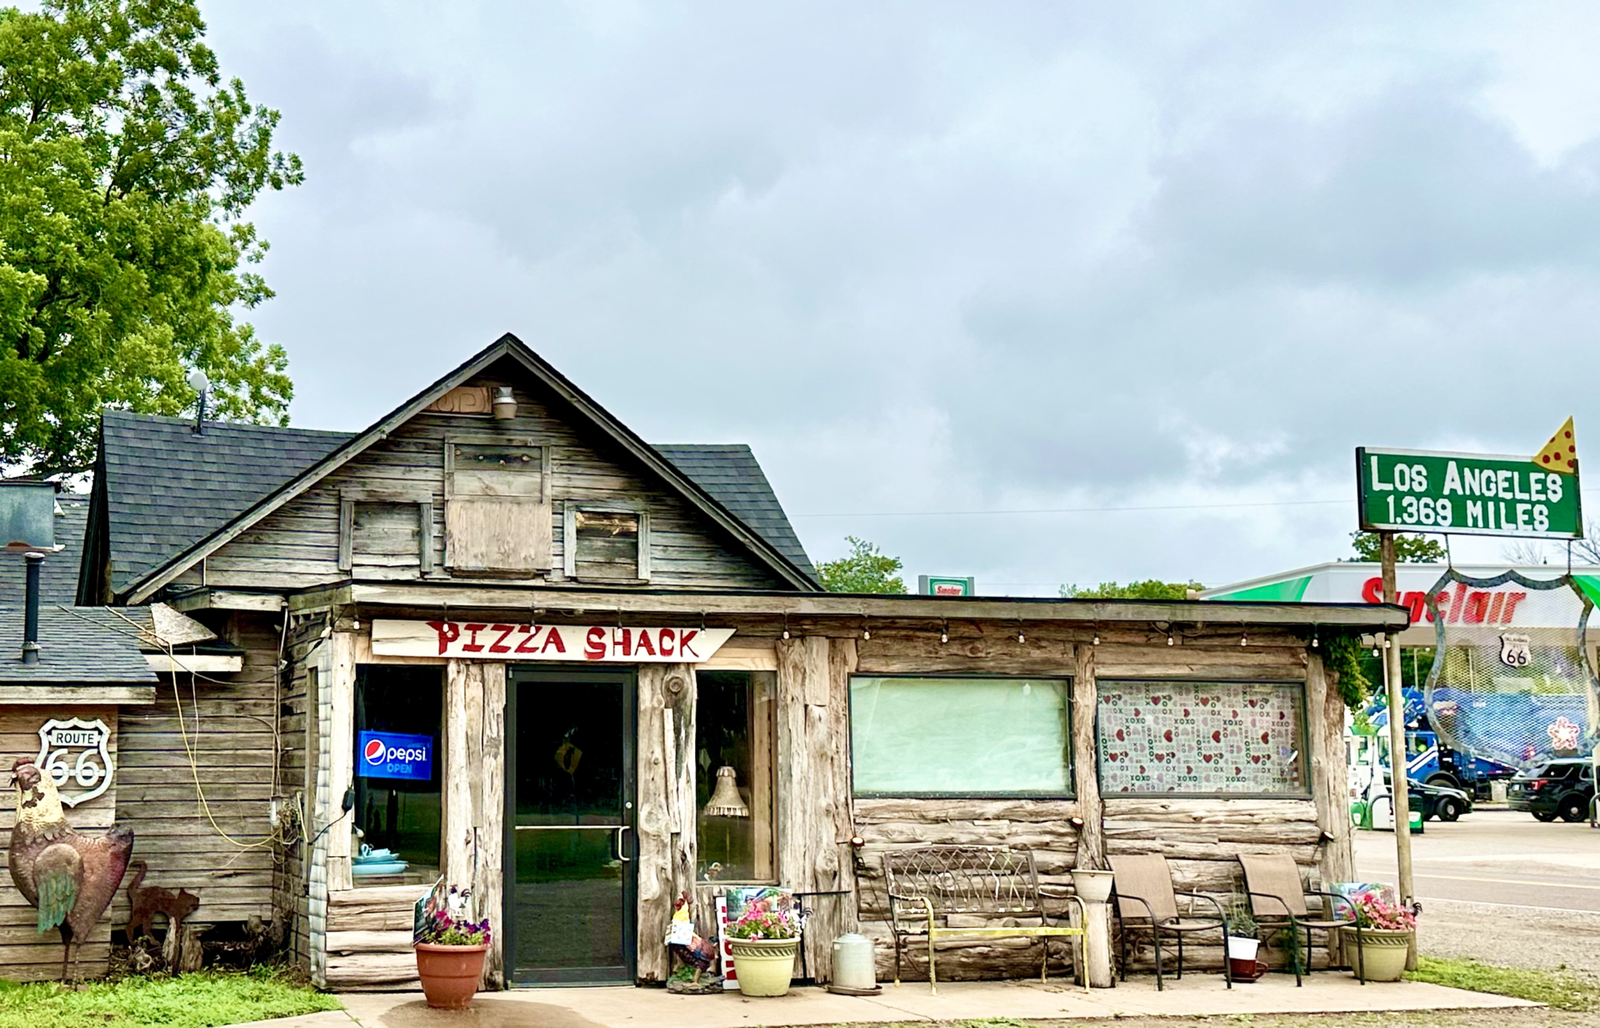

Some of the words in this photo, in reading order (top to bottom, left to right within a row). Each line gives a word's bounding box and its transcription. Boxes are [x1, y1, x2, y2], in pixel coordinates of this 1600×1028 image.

[1466, 500, 1549, 532] MILES
[426, 621, 567, 656] PIZZA
[583, 625, 700, 660] SHACK
[1507, 649, 1526, 665] 66
[56, 732, 95, 745] ROUTE
[386, 746, 427, 764] pepsi
[46, 748, 100, 787] 66
[386, 763, 413, 774] OPEN
